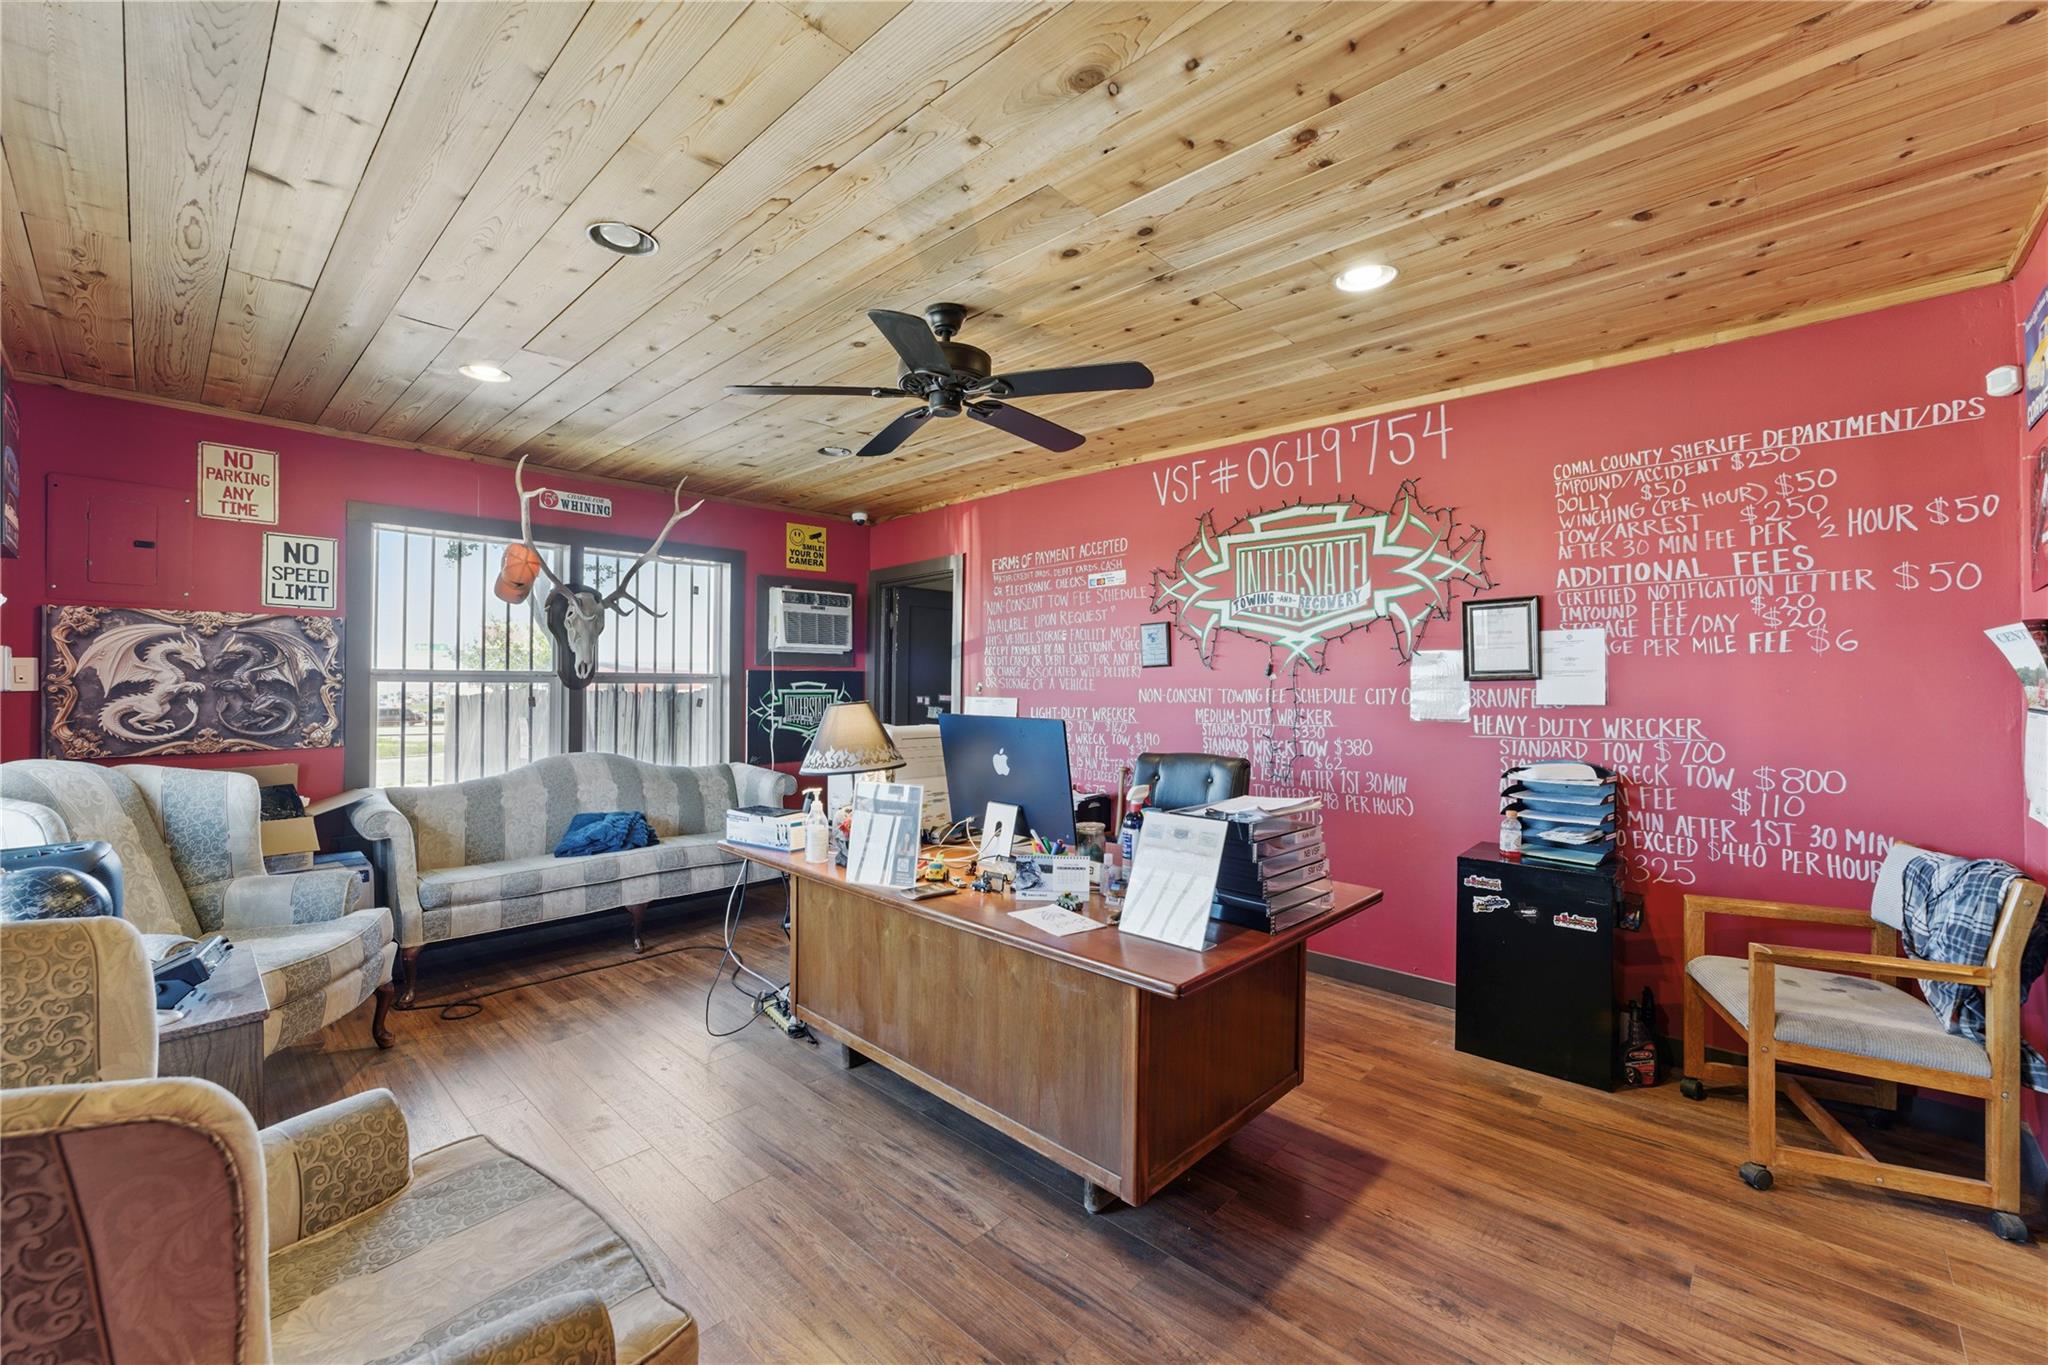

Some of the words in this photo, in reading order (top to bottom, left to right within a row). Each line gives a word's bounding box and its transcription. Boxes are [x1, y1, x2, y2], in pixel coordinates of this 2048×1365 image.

[1247, 404, 1453, 490] 0649754
[1553, 459, 1597, 480] COMAL
[1600, 448, 1663, 472] COUNTY
[1670, 433, 1752, 462] SHERIFF
[1762, 397, 1986, 449] DEPARTMENT/DPS
[223, 450, 253, 470] NO
[206, 466, 270, 487] PARKING
[1554, 457, 1722, 497] IMPOUND/ACCIDENT
[1731, 446, 1801, 471] $250
[222, 486, 254, 501] ANY
[1557, 492, 1613, 514] DOLLY
[1640, 479, 1686, 501] $50
[1559, 502, 1645, 530] WINCHING
[1652, 496, 1698, 518] (PER
[1702, 482, 1768, 509] HOUR)
[1774, 468, 1837, 498] $50
[218, 500, 259, 517] TIME
[561, 499, 611, 516] WHINING
[1554, 513, 1704, 546] TOW/ARREST
[1740, 494, 1828, 525] $250
[1557, 541, 1616, 560] AFTER
[1623, 539, 1649, 558] 30
[1658, 534, 1697, 554] MIN
[1705, 528, 1736, 551] FEE
[1750, 520, 1797, 546] PER
[1848, 504, 1918, 537] HOUR
[1925, 494, 2000, 525] $50
[283, 541, 319, 565] NO
[790, 549, 811, 558] YOUR
[802, 544, 824, 552] SMILE!
[1021, 553, 1033, 568] OF
[1034, 546, 1075, 566] PAYMENT
[1080, 537, 1128, 558] ACCEPTED
[789, 557, 824, 567] CAMERA
[1101, 558, 1122, 571] CASH
[1556, 557, 1708, 588] ADDITIONAL
[1732, 544, 1815, 577] FEES
[272, 566, 329, 584] SPEED
[1240, 539, 1360, 618] INTERSTATE
[1557, 587, 1637, 607] CERTIFIED
[1647, 577, 1773, 601] NOTIFICATION
[1785, 569, 1876, 595] LETTER
[1892, 561, 1982, 592] $50
[271, 583, 329, 602] LIMIT
[1005, 580, 1052, 596] ELECTRONIC
[1056, 576, 1086, 589] CHECKS
[1047, 592, 1069, 608] TOW
[1073, 591, 1091, 605] FEE
[1096, 586, 1147, 604] SCHEDULE
[1233, 592, 1274, 611] TOWING
[1299, 589, 1361, 609] RECOVERY
[1559, 604, 1638, 622] IMPOUND
[1651, 601, 1689, 619] FEE
[1750, 593, 1815, 616] $20
[987, 616, 1029, 633] AVAILABLE
[1034, 613, 1056, 628] UPON
[1651, 613, 1739, 637] FEE/DAY
[1762, 607, 1826, 629] $20
[1005, 632, 1034, 645] VEHICLE
[1036, 629, 1067, 644] STORAGE
[1070, 627, 1105, 641] FACILITY
[1110, 625, 1137, 641] MUST
[1644, 638, 1680, 656] PER
[1692, 634, 1736, 654] MILE
[1749, 629, 1795, 654] FEE
[1807, 624, 1858, 656] $6
[1054, 642, 1065, 654] AN
[1069, 640, 1115, 654] ELECTRONIC
[1045, 654, 1066, 666] DEBIT
[1069, 653, 1089, 665] CARD
[1094, 653, 1110, 667] FOR
[1113, 652, 1129, 665] ANY
[1104, 665, 1141, 679] DELIVERY
[1049, 677, 1055, 689] A
[1059, 677, 1096, 691] VEHICLE
[1138, 687, 1212, 704] NON-CONSENT
[1218, 687, 1262, 704] TOWING
[1265, 687, 1286, 704] FEE
[1295, 687, 1357, 704] SCHEDULE
[1365, 687, 1397, 704] CITY
[1030, 706, 1087, 719] LIGHT-DUTY
[1092, 707, 1136, 722] WRECKER
[1195, 707, 1272, 725] MEDIUM-DUTY
[1276, 708, 1334, 727] WRECKER
[1078, 721, 1095, 732] TOW
[1202, 723, 1248, 738] STANDARD
[1248, 724, 1275, 738] TOW
[1292, 725, 1325, 739] $330
[1473, 715, 1593, 737] HEAVY-DUTY
[1602, 718, 1708, 740] WRECKER
[1075, 732, 1105, 745] WRECK
[1111, 733, 1130, 746] TOW
[1135, 732, 1160, 748] $190
[1202, 737, 1249, 754] STANDARD
[1253, 740, 1296, 757] WRECK
[1299, 740, 1328, 757] TOW
[1334, 737, 1373, 758] $380
[1095, 745, 1109, 760] FEE
[1500, 739, 1588, 759] STANDARD
[1601, 742, 1644, 763] TOW
[1654, 738, 1726, 765] $700
[1253, 755, 1271, 768] MIN
[1314, 756, 1347, 771] $62
[1300, 769, 1334, 792] AFTER
[1340, 770, 1360, 794] 1ST
[1365, 772, 1381, 793] 30
[1383, 773, 1408, 796] MIN
[1682, 764, 1735, 791] TOW
[1753, 766, 1846, 795] $800
[1345, 794, 1370, 814] PER
[1373, 796, 1414, 816] HOUR)
[1640, 786, 1677, 811] FEE
[1731, 787, 1805, 818] $110
[1627, 810, 1664, 833] MIN
[1675, 815, 1738, 842] AFTER
[1751, 818, 1796, 847] 1ST
[1809, 824, 1837, 849] 30
[1845, 828, 1895, 856] MIN
[1632, 830, 1698, 857] EXCEED
[1707, 838, 1767, 868] $440
[1782, 849, 1823, 876] PER
